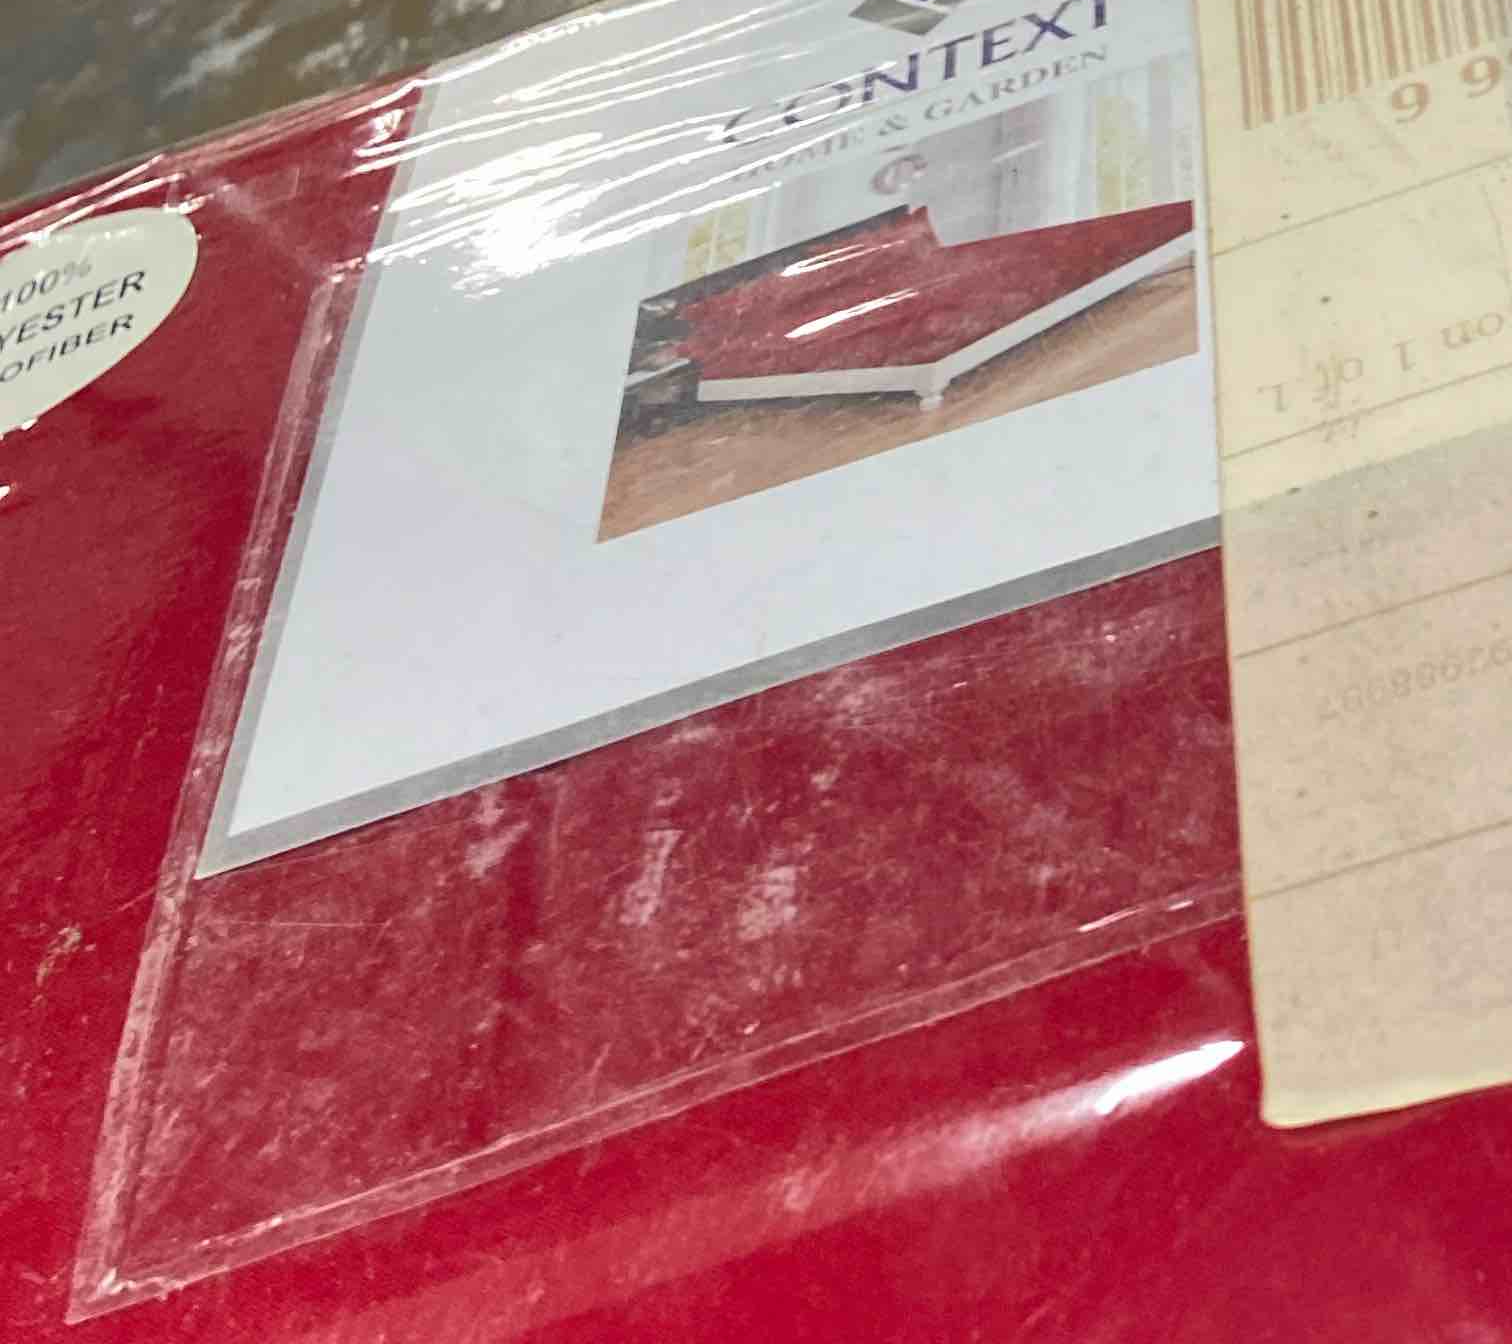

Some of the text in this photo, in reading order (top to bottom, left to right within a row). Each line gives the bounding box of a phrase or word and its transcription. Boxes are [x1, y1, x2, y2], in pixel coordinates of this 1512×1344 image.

[876, 110, 908, 137] &
[923, 44, 1108, 122] GARDEN
[1387, 75, 1433, 129] 6
[2, 257, 92, 312] 100%
[1391, 337, 1416, 376] 1
